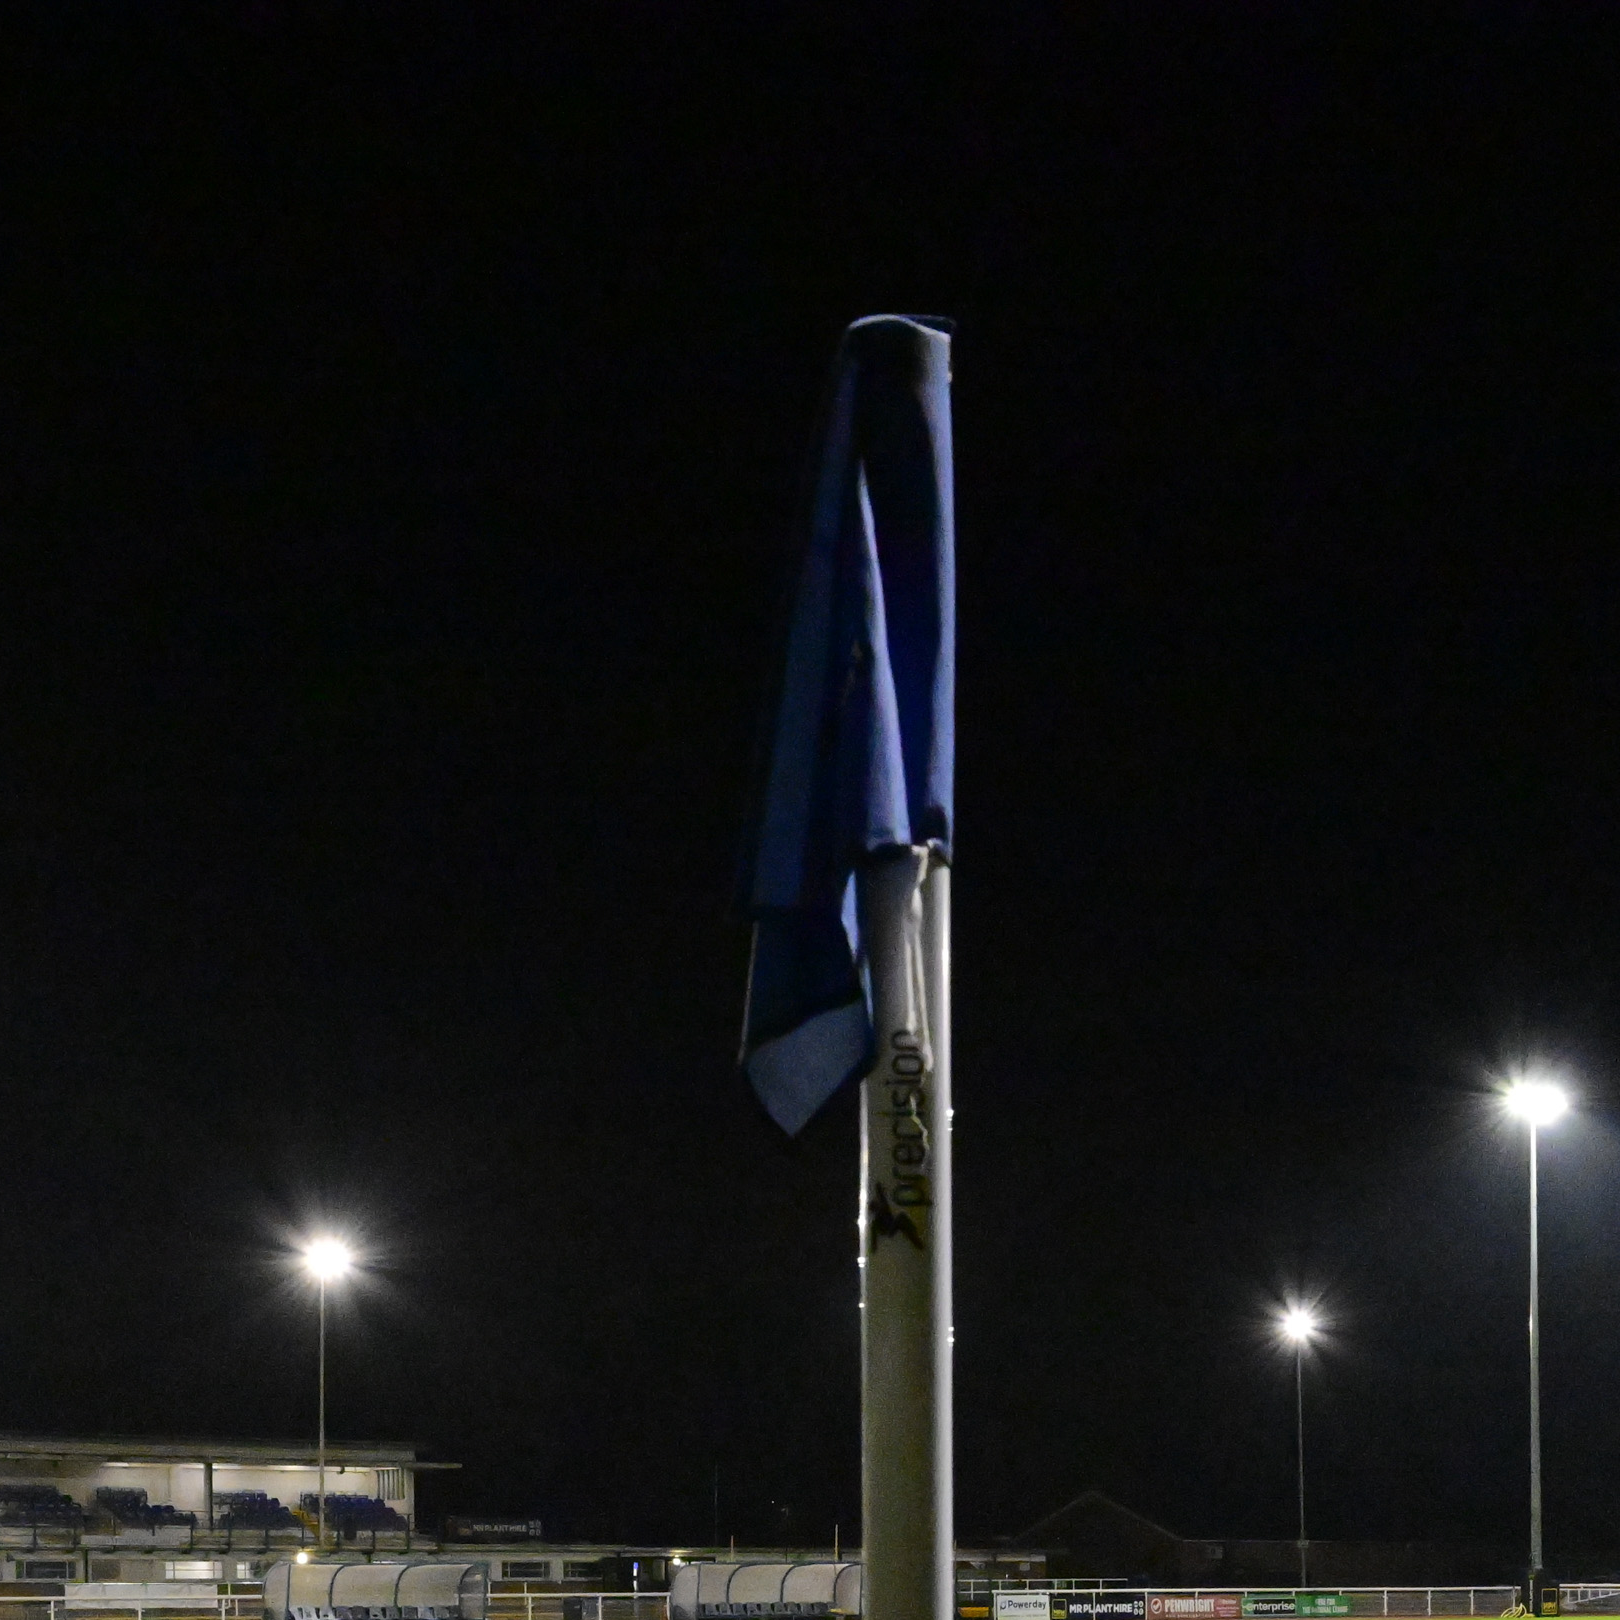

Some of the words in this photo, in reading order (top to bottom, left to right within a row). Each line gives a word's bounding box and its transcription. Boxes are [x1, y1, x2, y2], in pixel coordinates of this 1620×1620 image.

[885, 1029, 932, 1206] precision
[1007, 1600, 1047, 1610] Powerday
[1069, 1604, 1083, 1614] MR
[1083, 1604, 1113, 1613] PLANT
[1113, 1603, 1133, 1613] HIRE
[1247, 1601, 1295, 1612] enterprise
